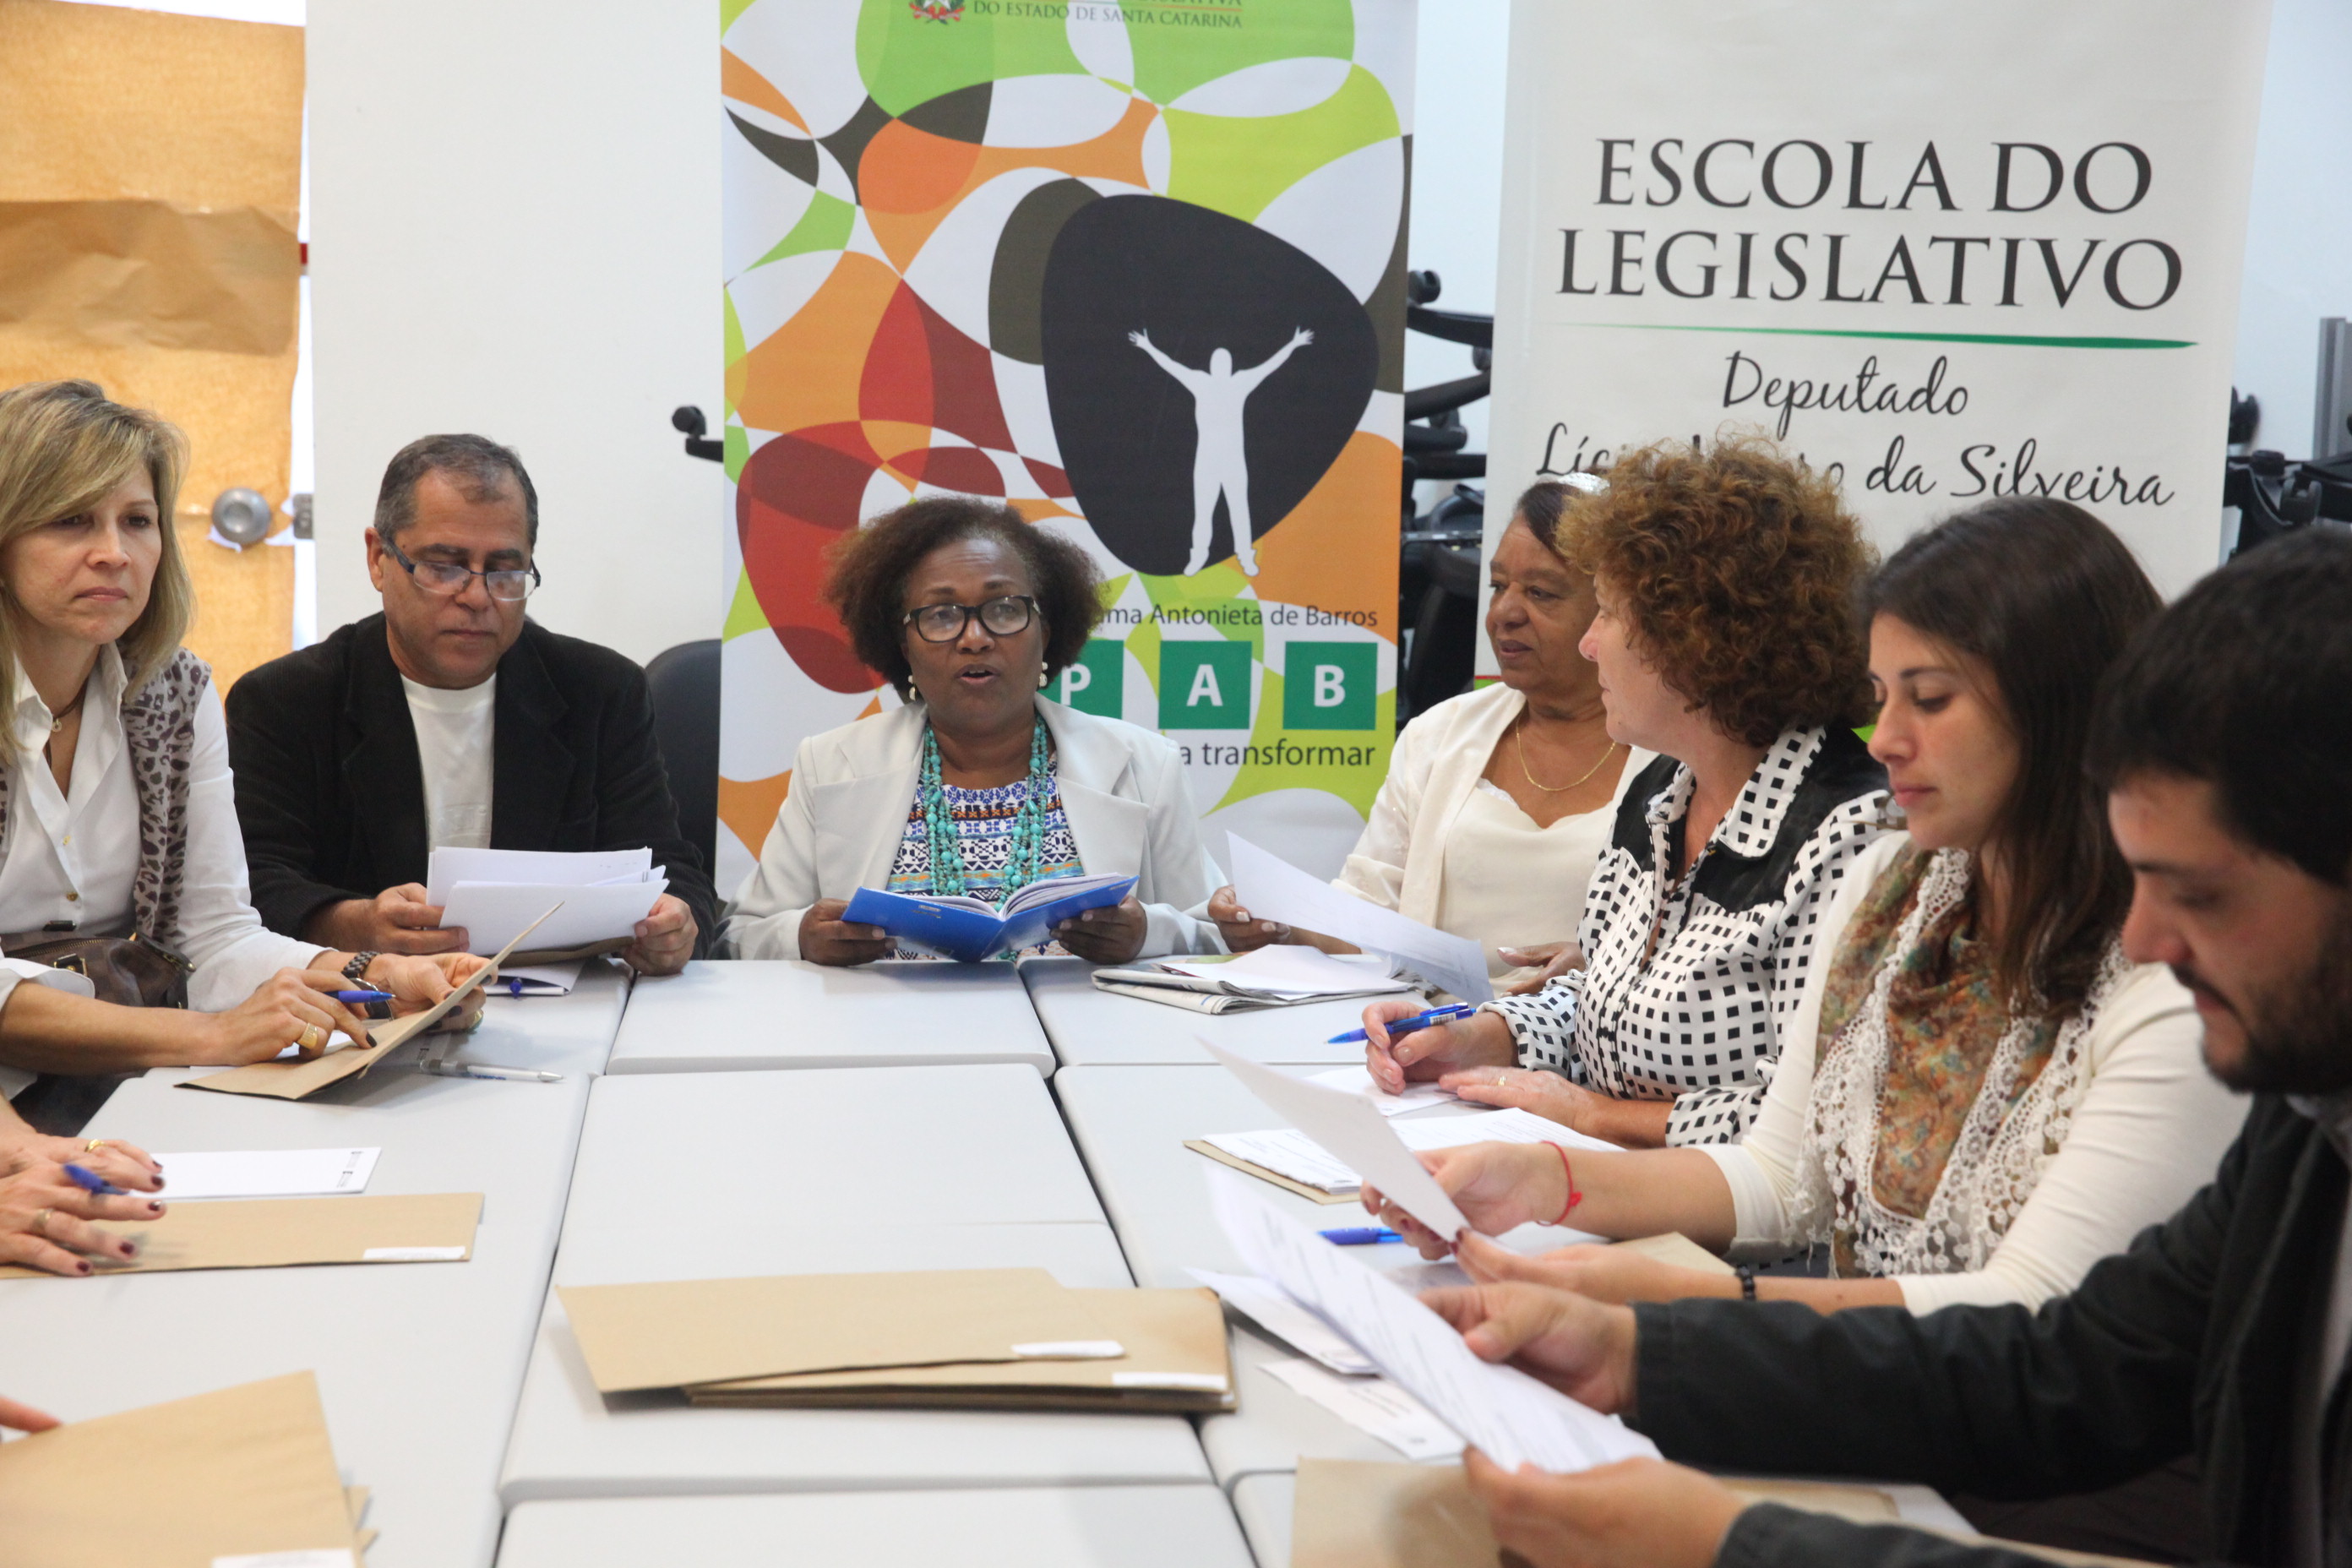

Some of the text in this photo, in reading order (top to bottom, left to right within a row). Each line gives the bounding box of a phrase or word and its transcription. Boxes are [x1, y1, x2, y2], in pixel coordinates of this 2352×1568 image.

[973, 1, 1243, 29] DO ESTADO DE SANTA CATARINA
[1594, 138, 2153, 215] ESCOLA DO
[1555, 228, 2183, 311] LEGISLATIVO
[1722, 351, 1969, 444] Deputado
[1865, 434, 1936, 496] da
[1950, 438, 2175, 506] Silveira
[1149, 603, 1263, 626] Antonieta
[1271, 605, 1298, 625] de
[1306, 604, 1379, 628] Barros
[1202, 738, 1376, 766] transformar
